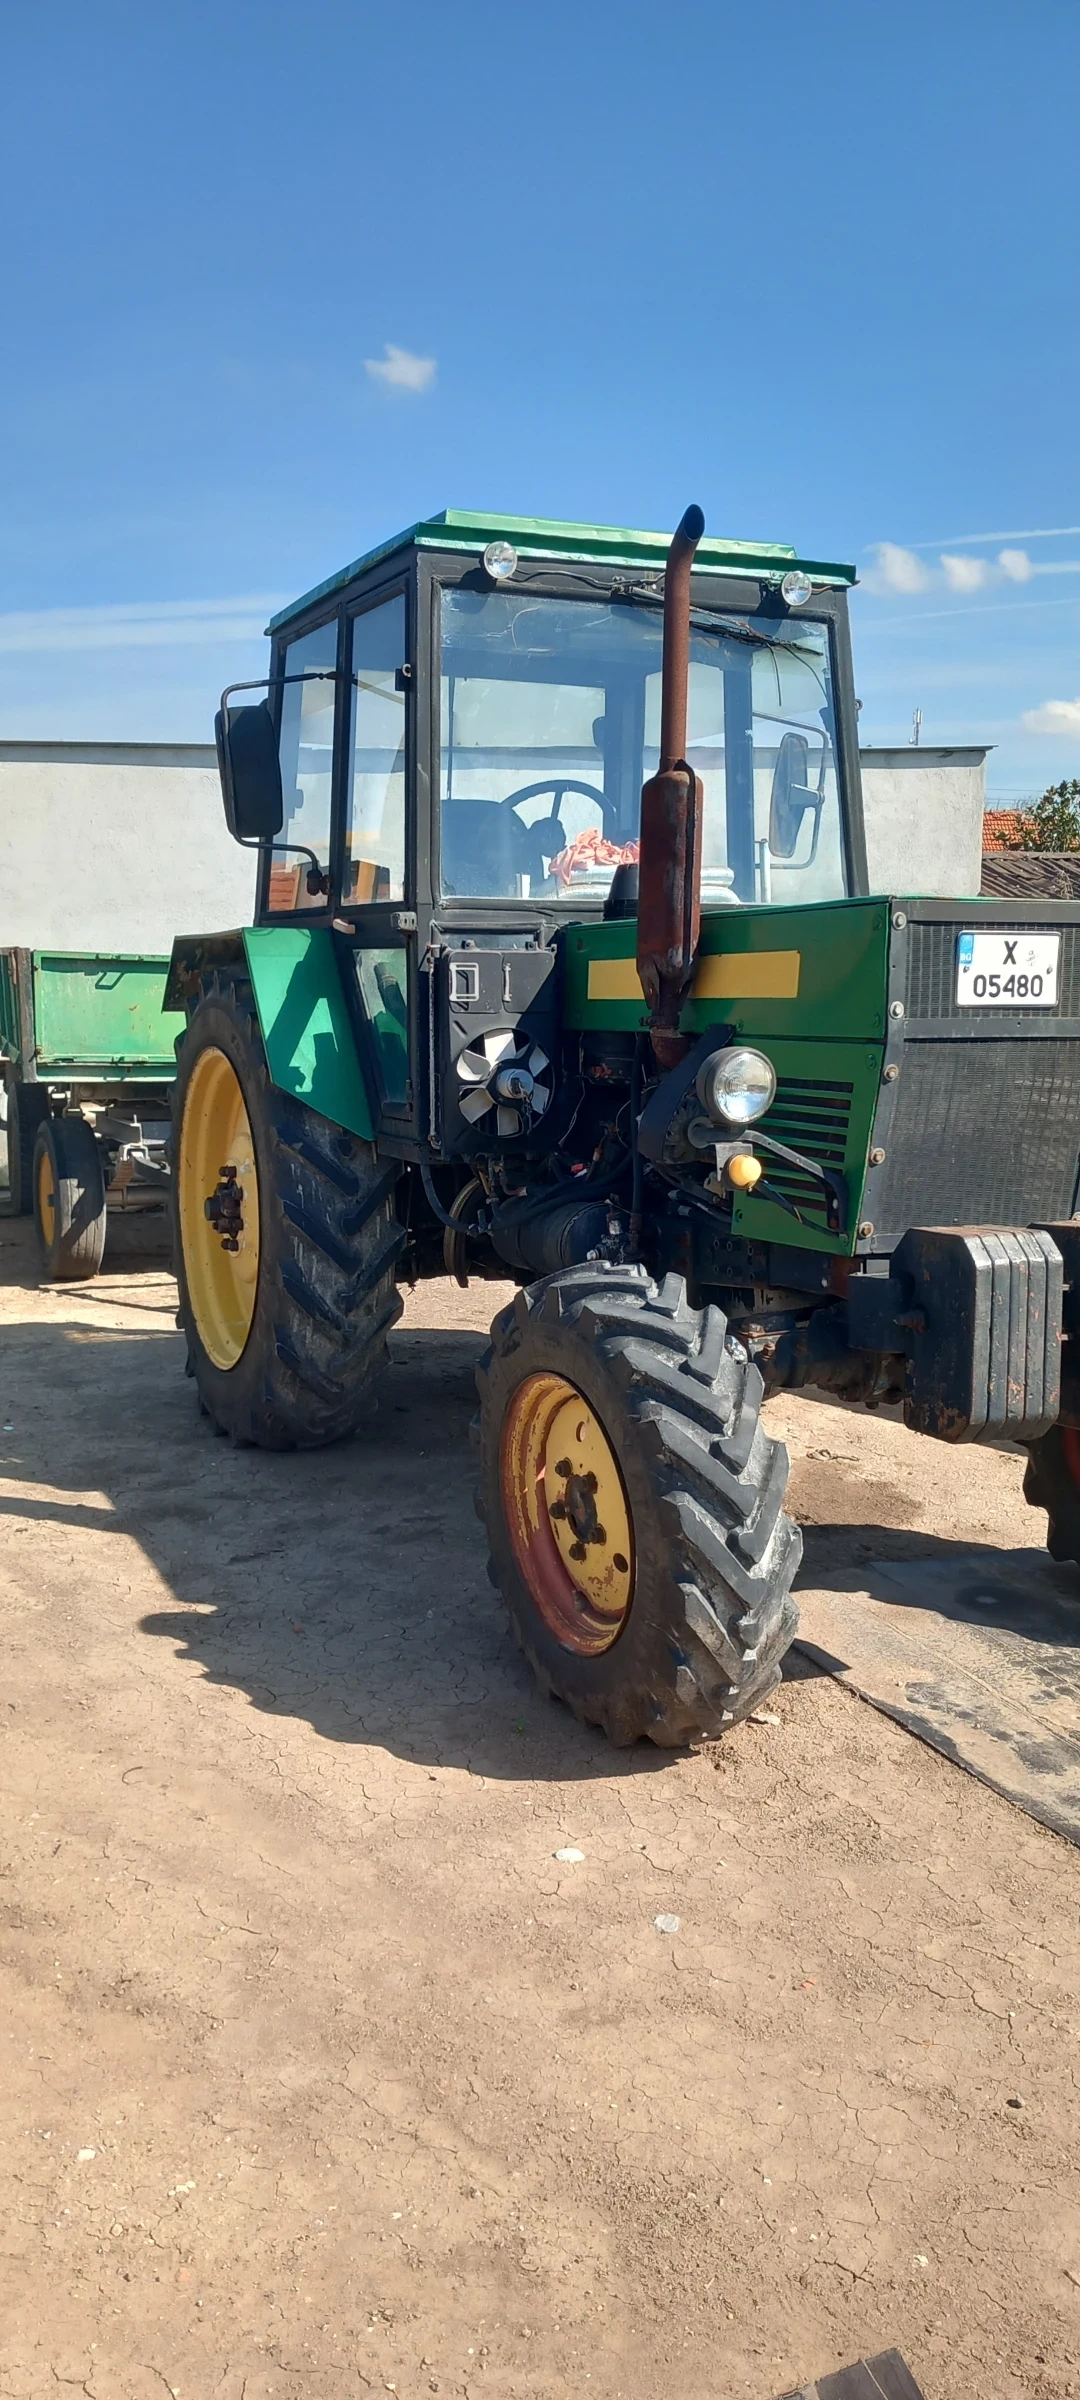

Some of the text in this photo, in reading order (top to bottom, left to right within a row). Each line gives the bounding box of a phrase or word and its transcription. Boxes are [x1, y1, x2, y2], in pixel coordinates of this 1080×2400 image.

[960, 953, 972, 961] BG
[1003, 941, 1018, 965] X
[973, 974, 1043, 998] 05480
